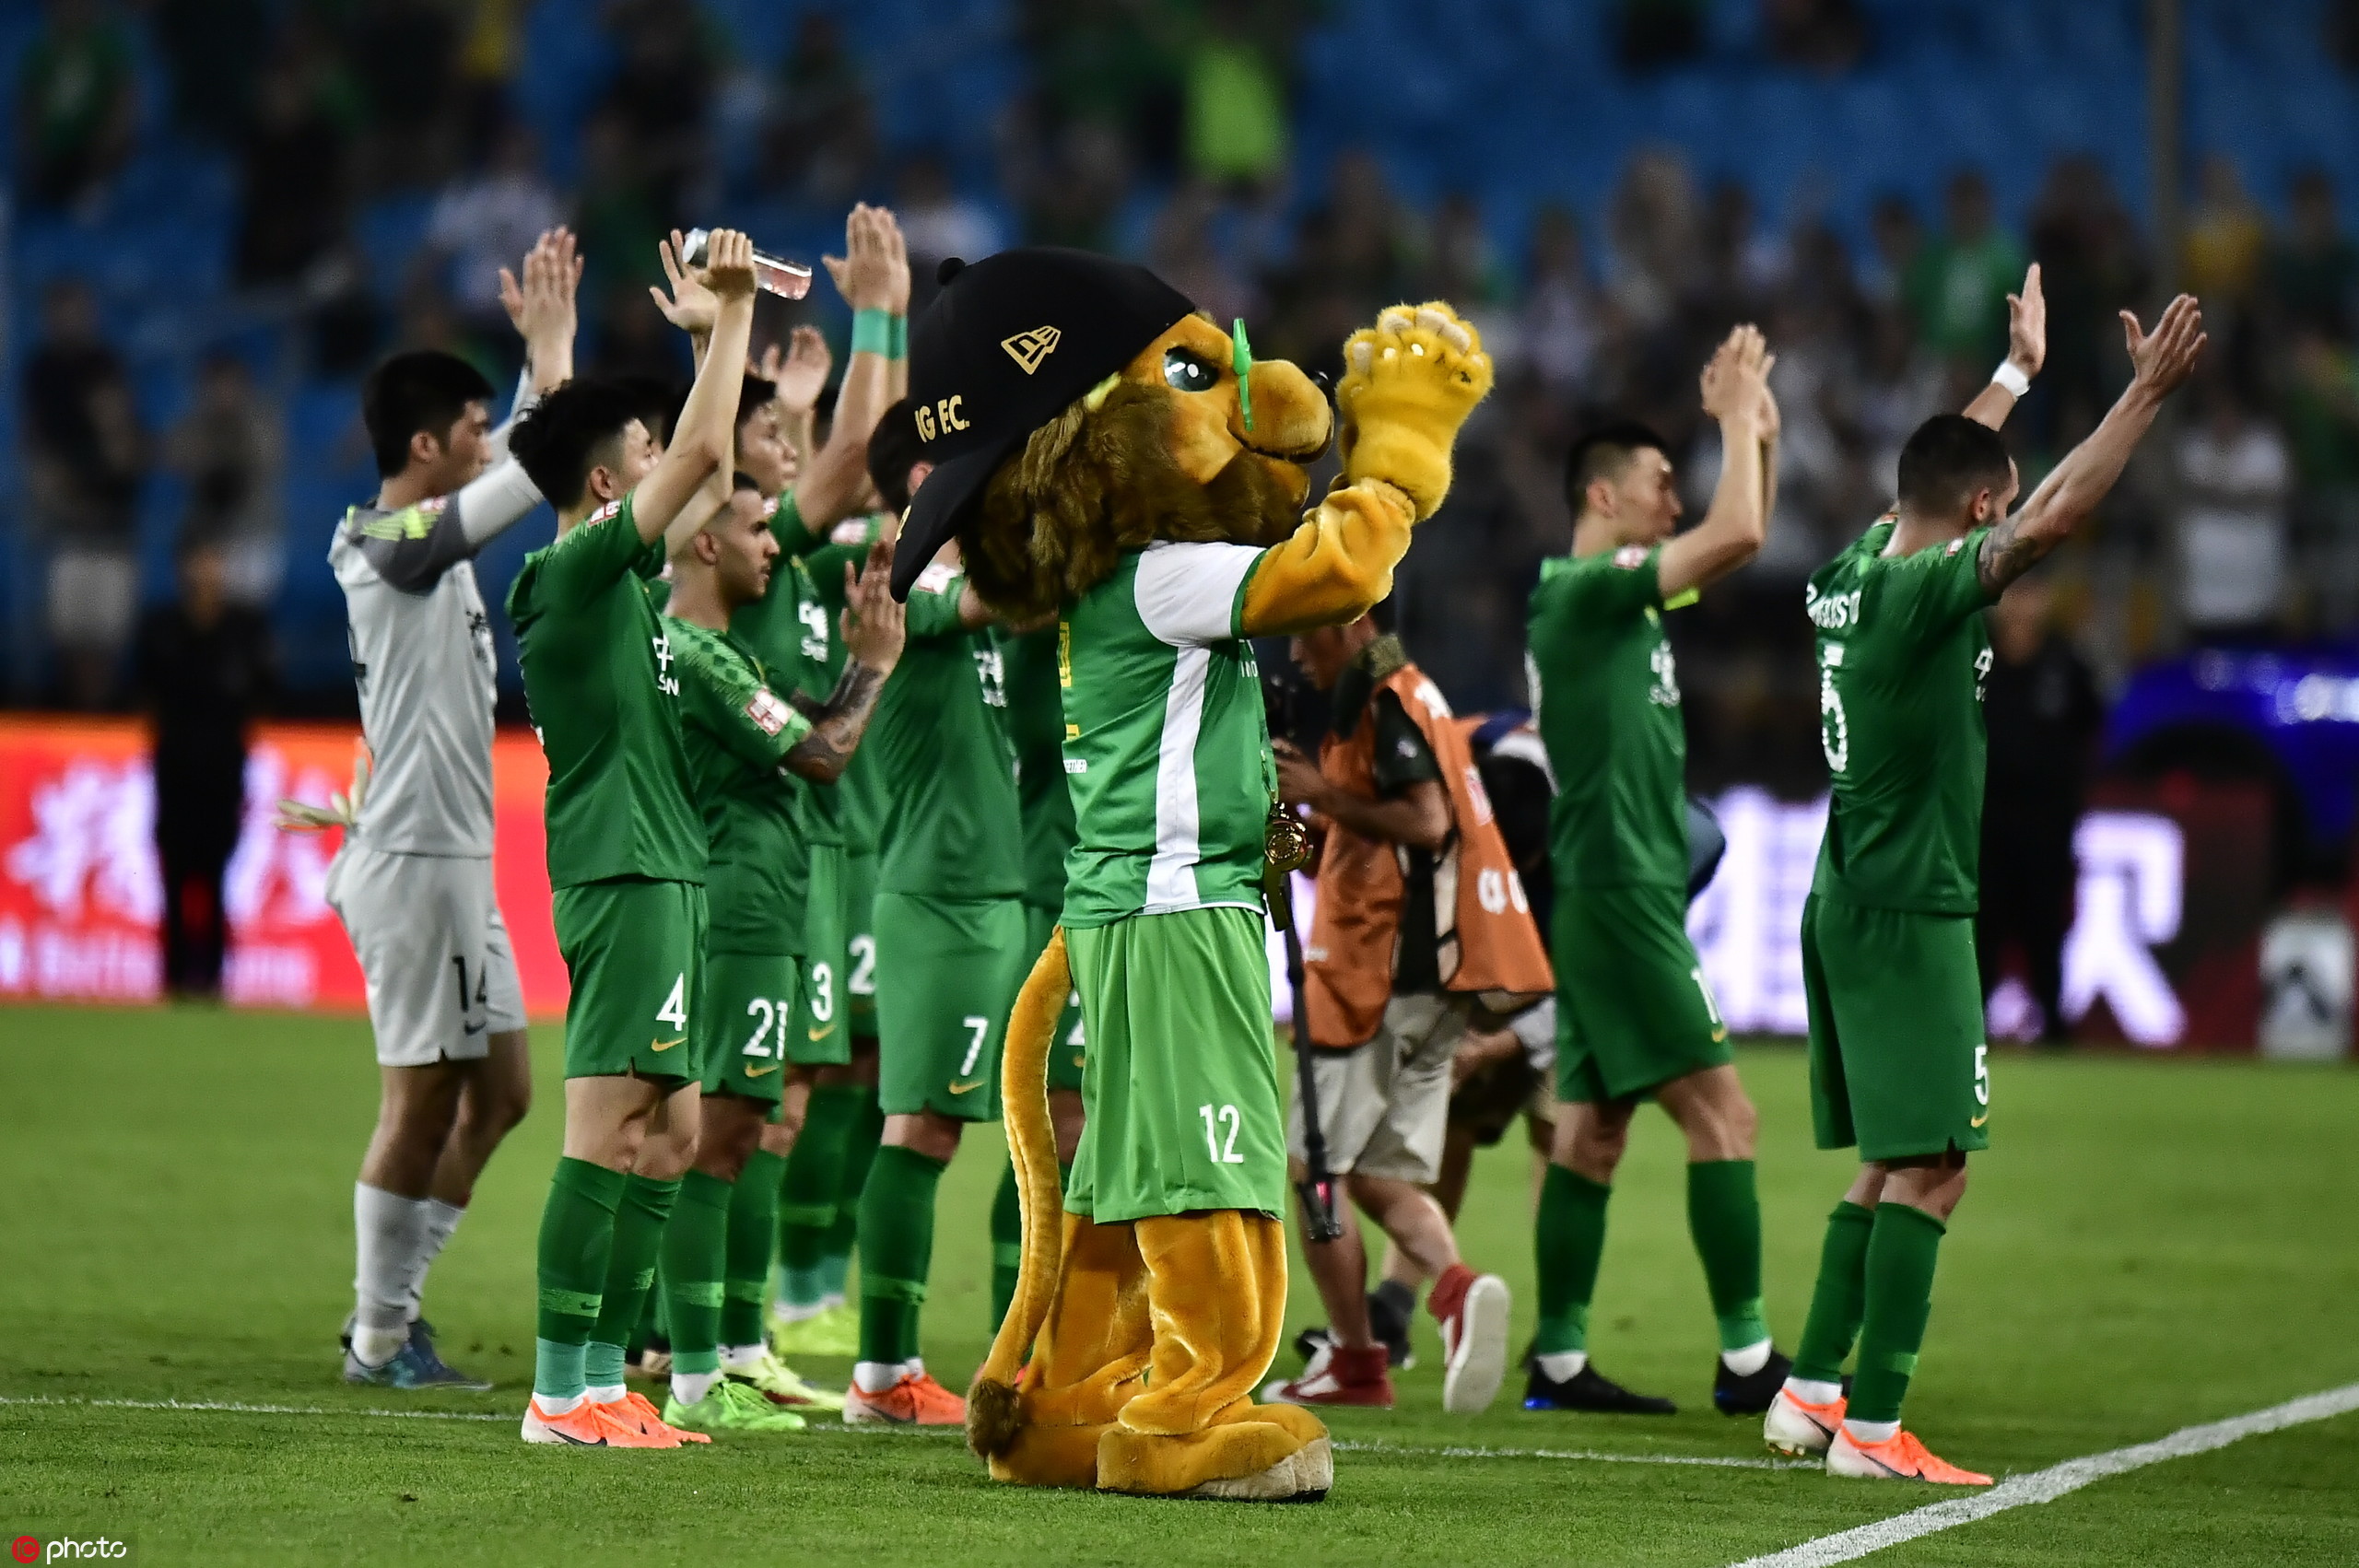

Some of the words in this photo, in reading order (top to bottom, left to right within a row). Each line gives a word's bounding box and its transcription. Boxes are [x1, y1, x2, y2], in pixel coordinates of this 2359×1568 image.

[655, 972, 687, 1032] 4
[811, 963, 832, 1022] 3
[742, 998, 789, 1060] 21
[960, 1016, 989, 1076] 7
[1974, 1046, 1989, 1106] 5
[1199, 1104, 1244, 1164] 12
